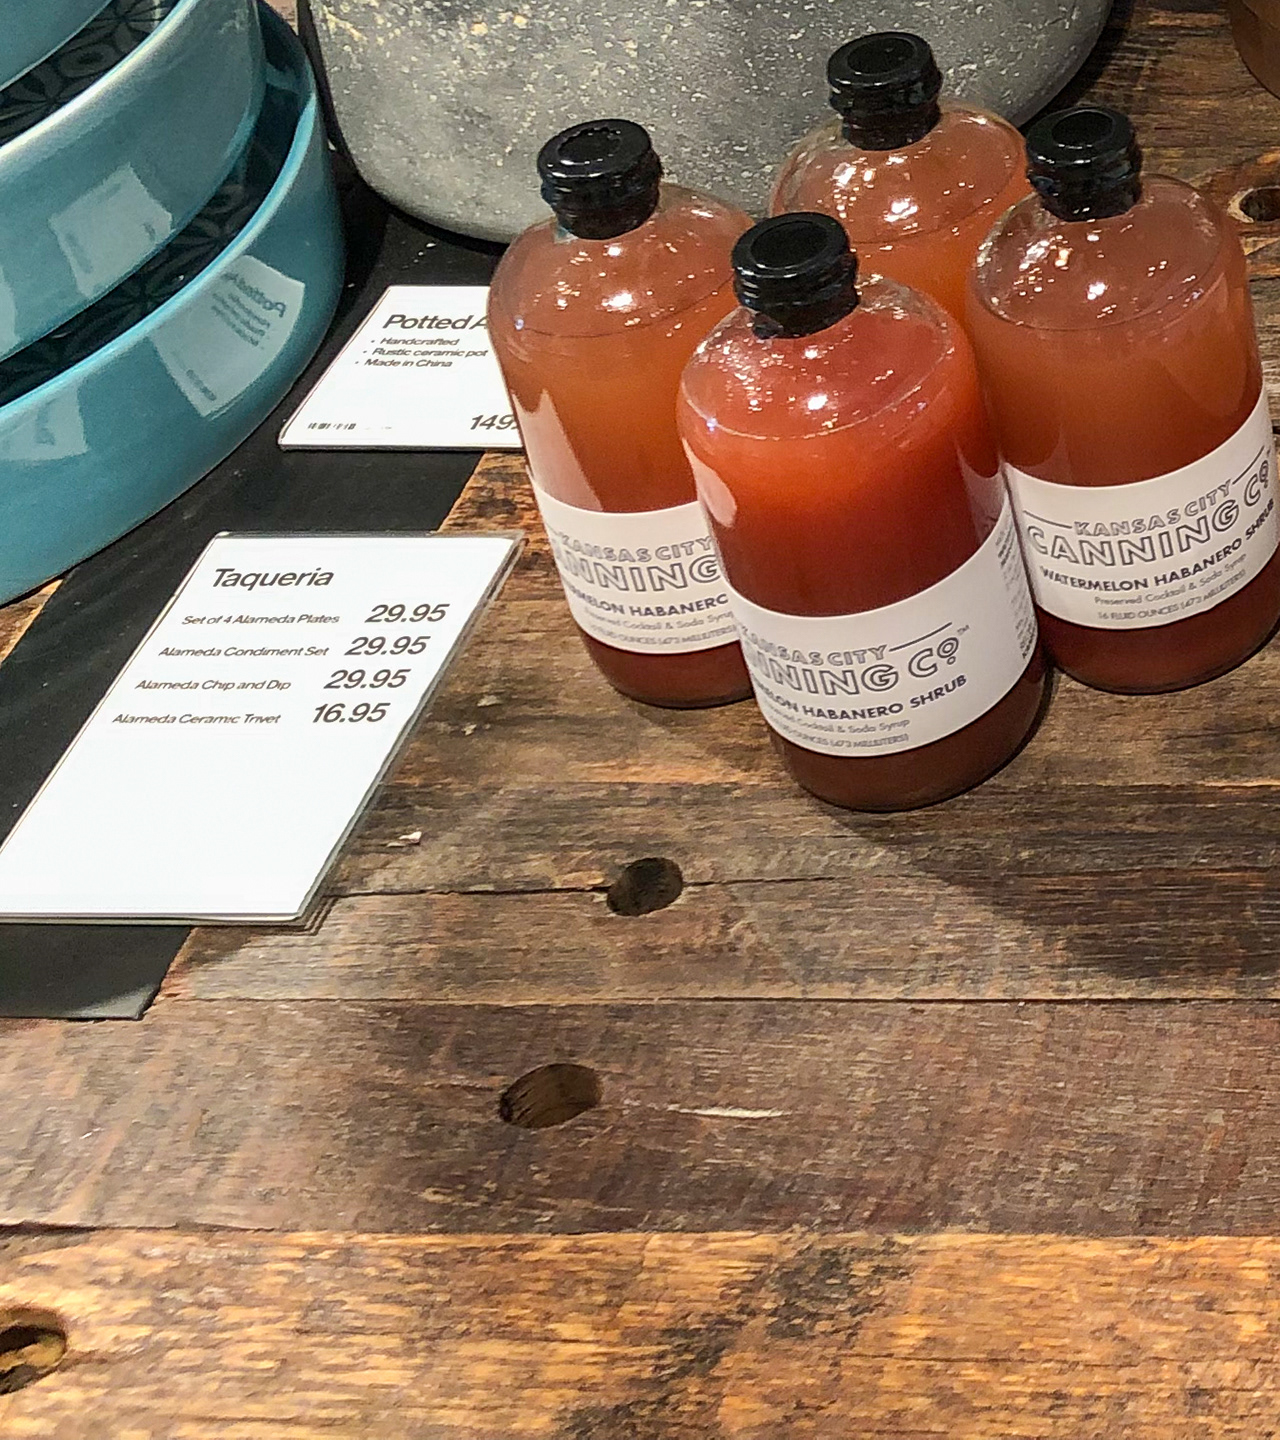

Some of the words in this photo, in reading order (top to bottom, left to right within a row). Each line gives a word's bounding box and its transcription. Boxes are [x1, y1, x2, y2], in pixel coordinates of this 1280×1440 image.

[382, 314, 474, 330] Potted
[371, 347, 412, 357] Rustic
[413, 349, 465, 357] ceramic
[465, 349, 488, 358] pot
[380, 337, 460, 346] Handcrafted
[364, 358, 401, 367] Made
[402, 359, 414, 367] in
[415, 359, 453, 367] China
[1074, 509, 1181, 537] KANSAS
[1184, 478, 1232, 518] CITY
[1027, 499, 1240, 567] CANNING
[1040, 565, 1149, 592] WATERMELON
[1154, 537, 1242, 586] HABANERO
[1245, 497, 1274, 541] SHRUB
[655, 535, 712, 561] CITY
[213, 567, 334, 591] Taqueria
[181, 615, 207, 626] Set
[207, 616, 223, 625] of
[223, 615, 232, 624] 4
[233, 615, 296, 624] Alameda
[297, 614, 340, 624] Plates
[364, 603, 450, 624] 29.95
[158, 647, 222, 657] Alameda
[224, 647, 304, 657] Condiment
[304, 646, 330, 656] Set
[344, 635, 431, 656] 29.95
[827, 644, 888, 667] CITY
[134, 679, 200, 690] Alameda
[201, 679, 236, 691] Chip
[236, 680, 267, 690] and
[266, 679, 292, 691] Dip
[323, 669, 411, 690] 29.95
[802, 702, 904, 720] HABANERO
[910, 674, 967, 709] SHRUB
[112, 713, 176, 724] Alameda
[178, 713, 241, 724] Ceramic
[243, 713, 282, 724] Trivet
[312, 702, 391, 724] 16.95
